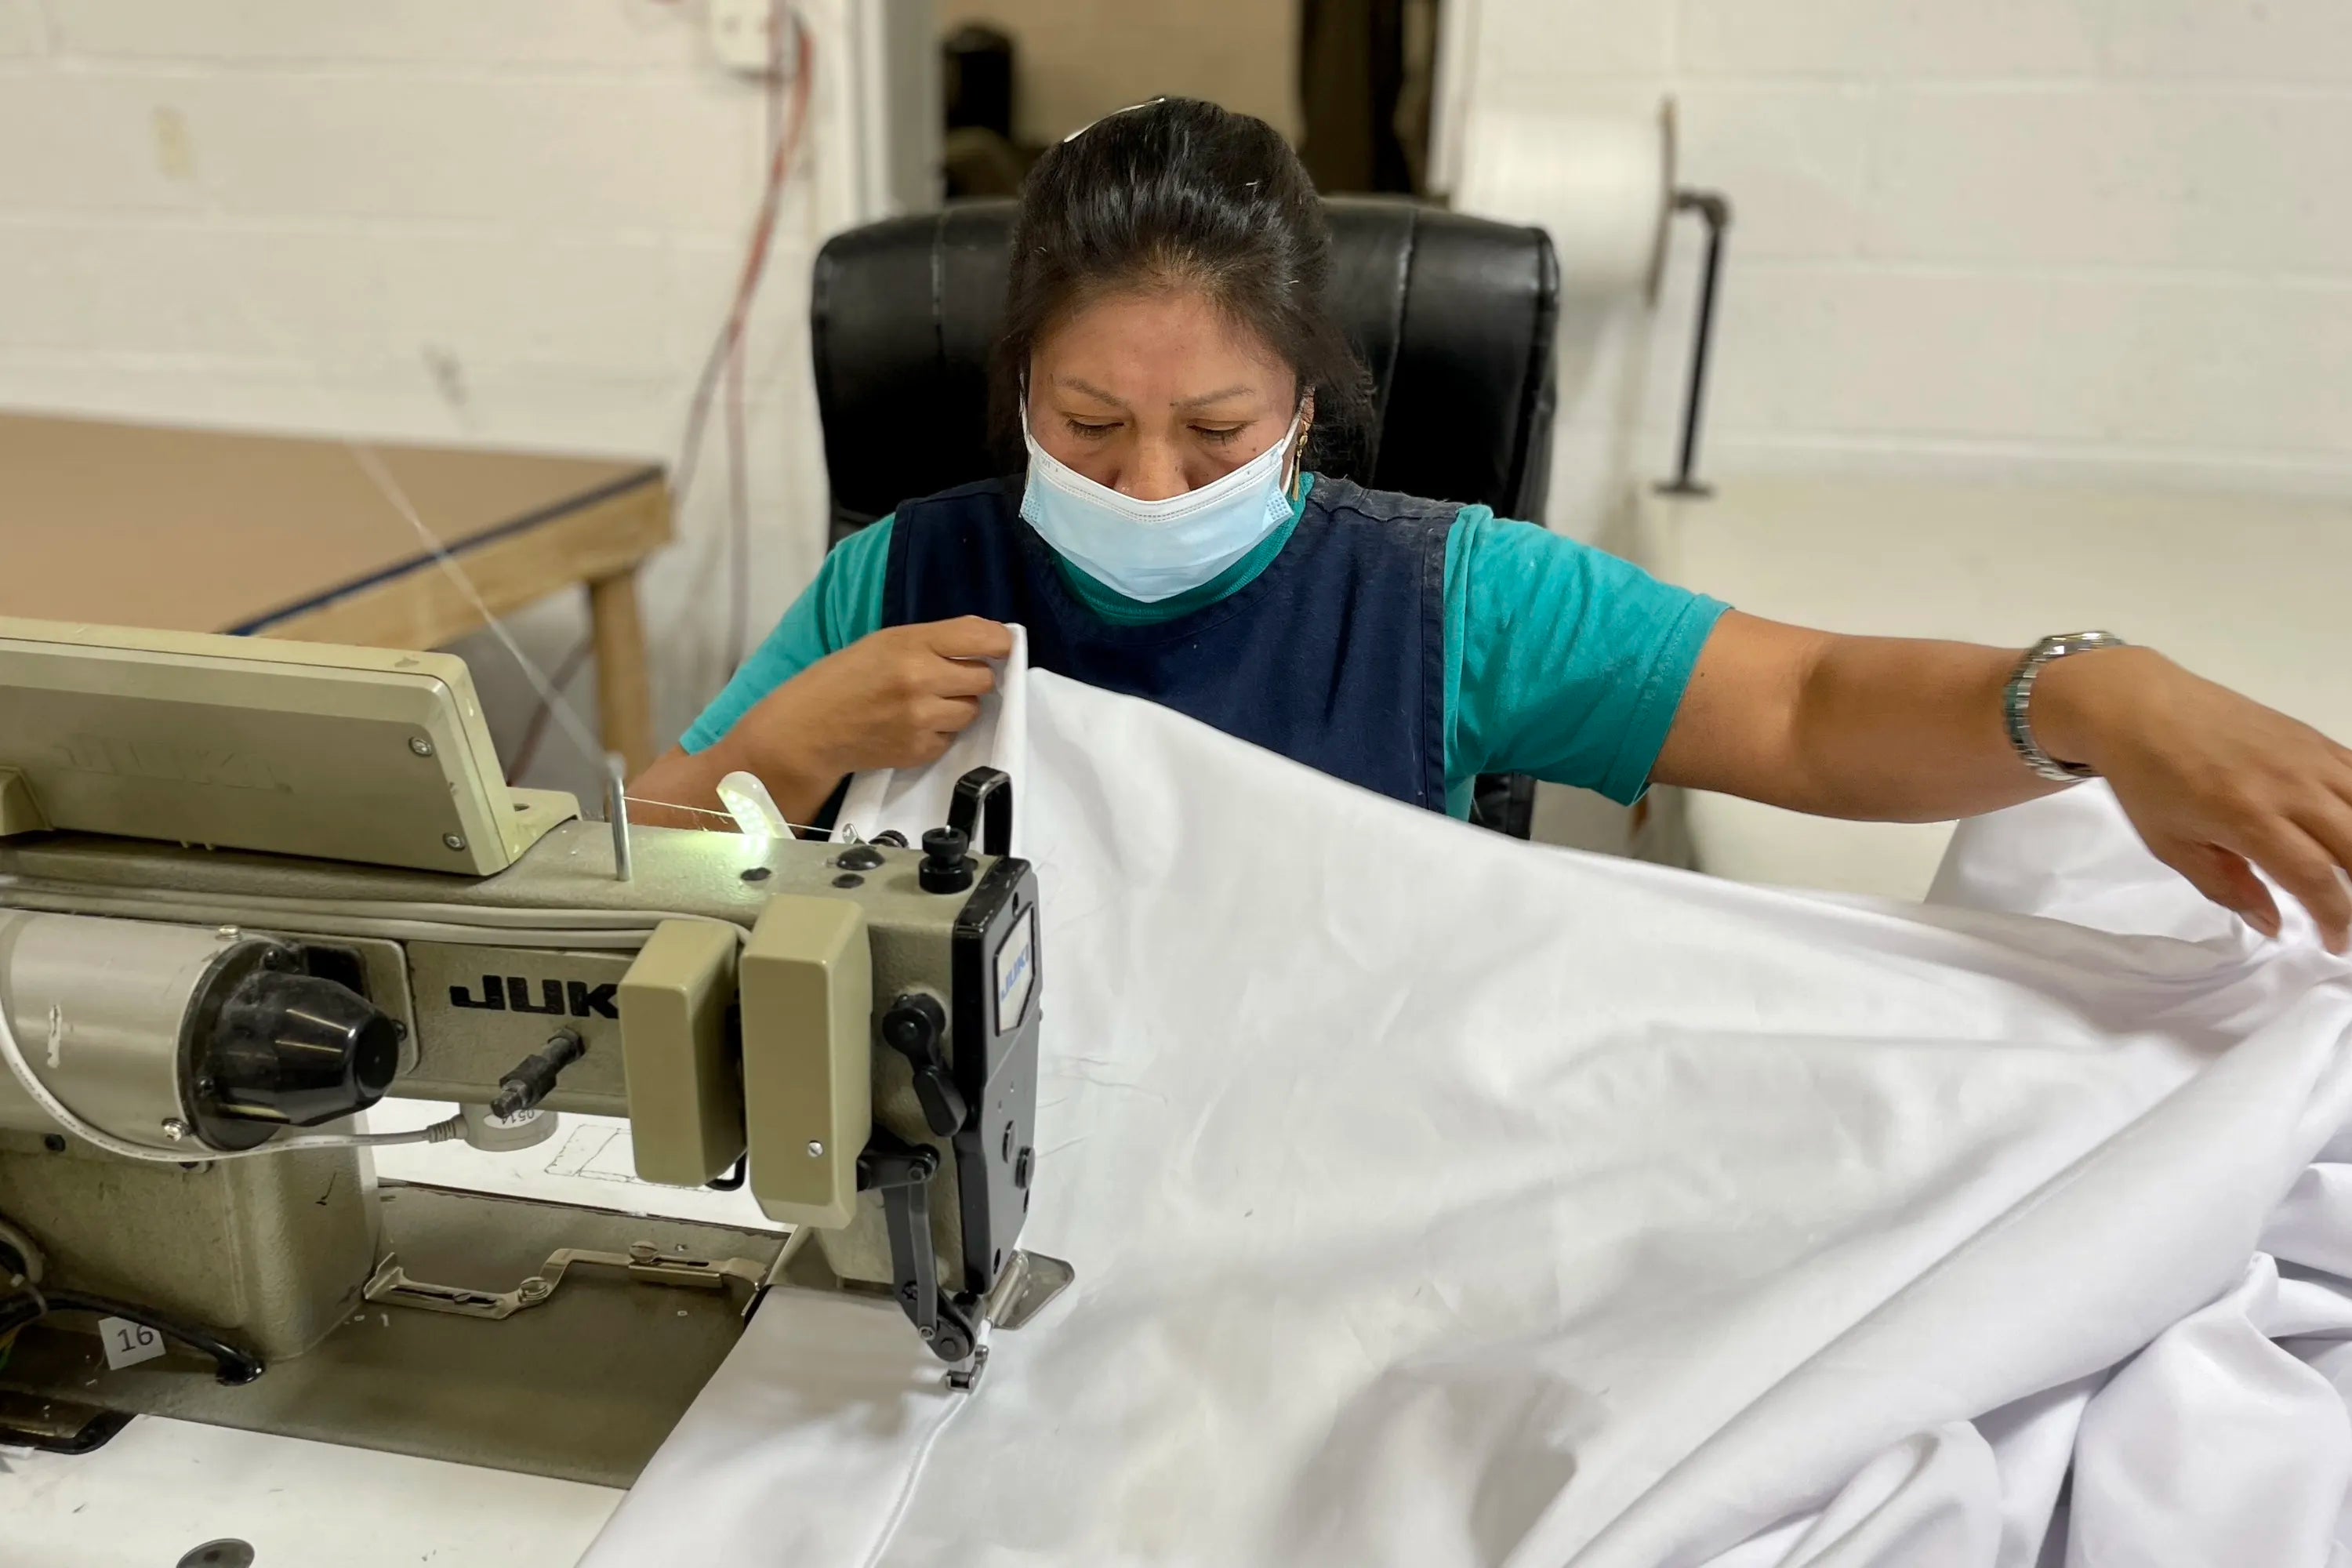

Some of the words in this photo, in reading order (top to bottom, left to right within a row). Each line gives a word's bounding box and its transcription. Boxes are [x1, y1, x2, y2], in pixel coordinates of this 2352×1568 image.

[1000, 943, 1030, 1002] JUKI
[448, 975, 619, 1020] JUK
[117, 1324, 154, 1353] 16
